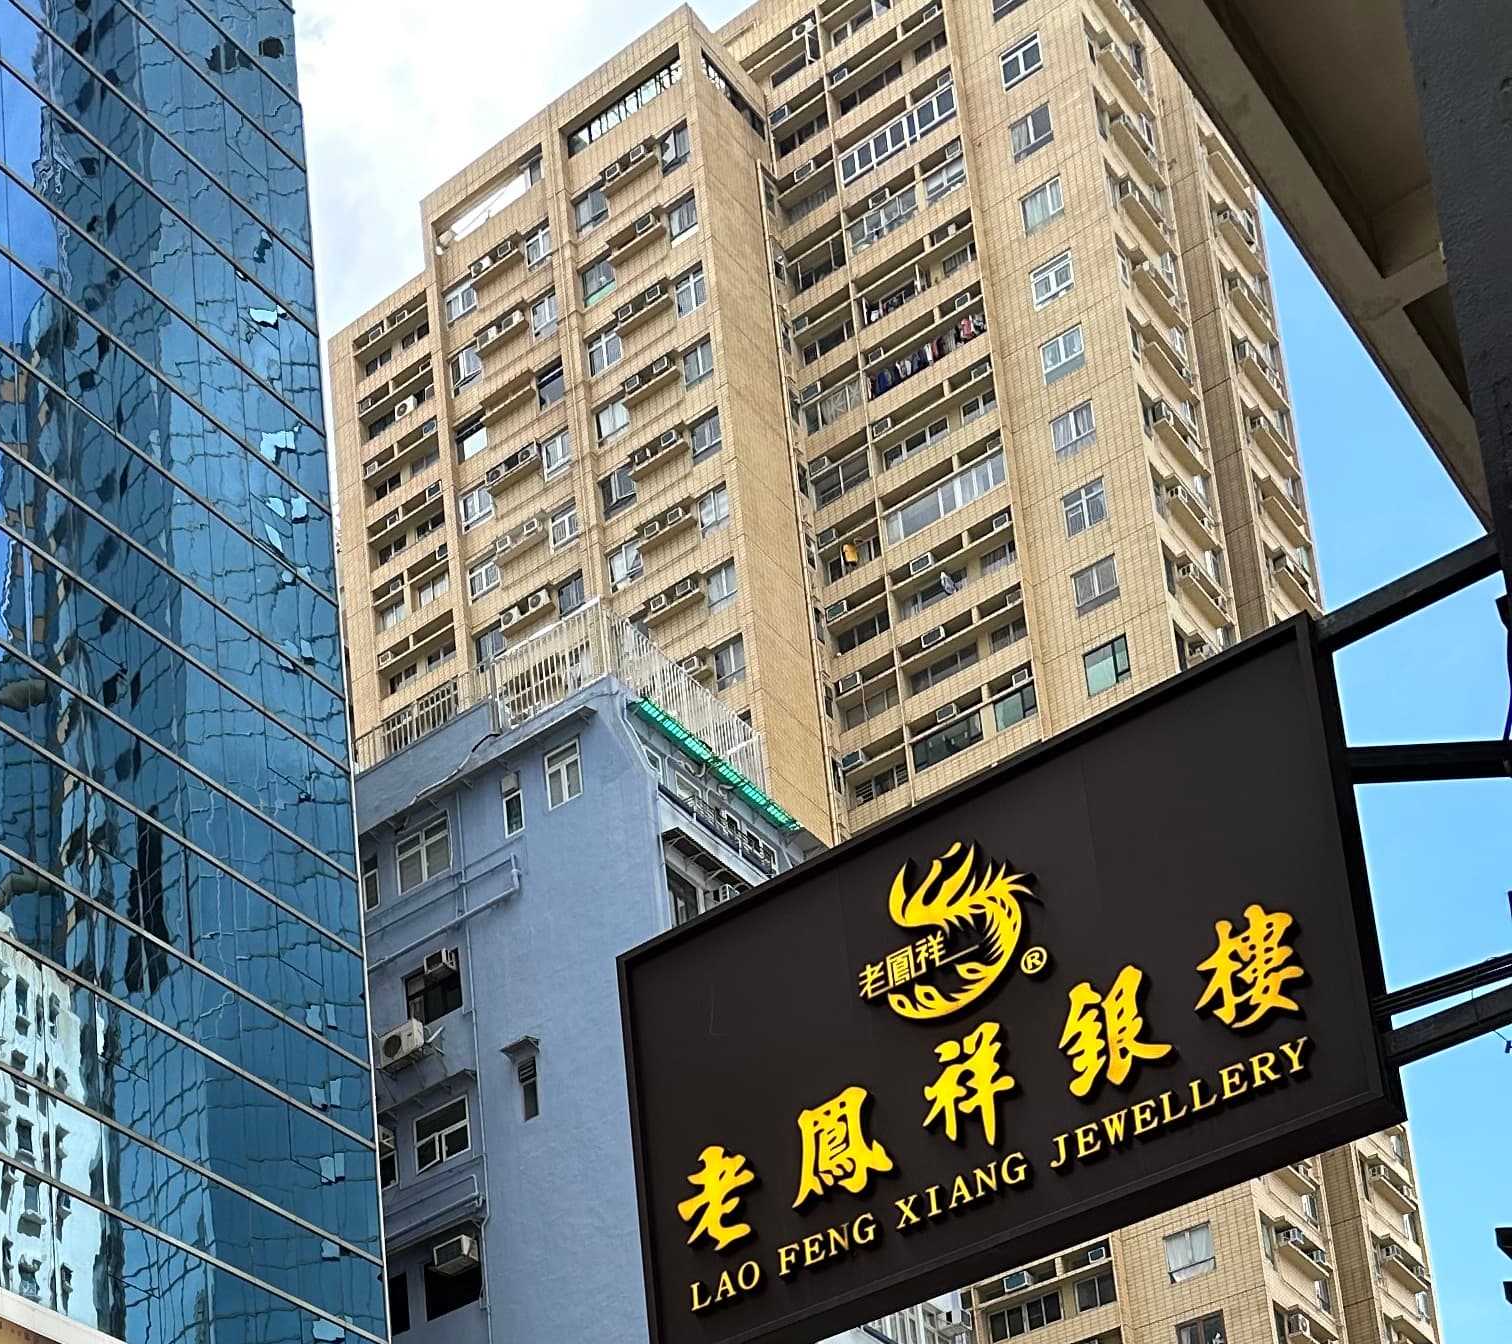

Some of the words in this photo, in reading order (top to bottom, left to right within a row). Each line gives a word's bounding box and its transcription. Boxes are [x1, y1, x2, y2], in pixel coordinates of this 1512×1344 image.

[677, 903, 1306, 1251] 老鳳祥銀樓
[859, 932, 946, 1000] 老鳳祥
[690, 1259, 761, 1312] LAO
[777, 1216, 877, 1278] FENG
[895, 1152, 1027, 1231] XIANG
[1050, 1036, 1310, 1169] JEWELLERY
